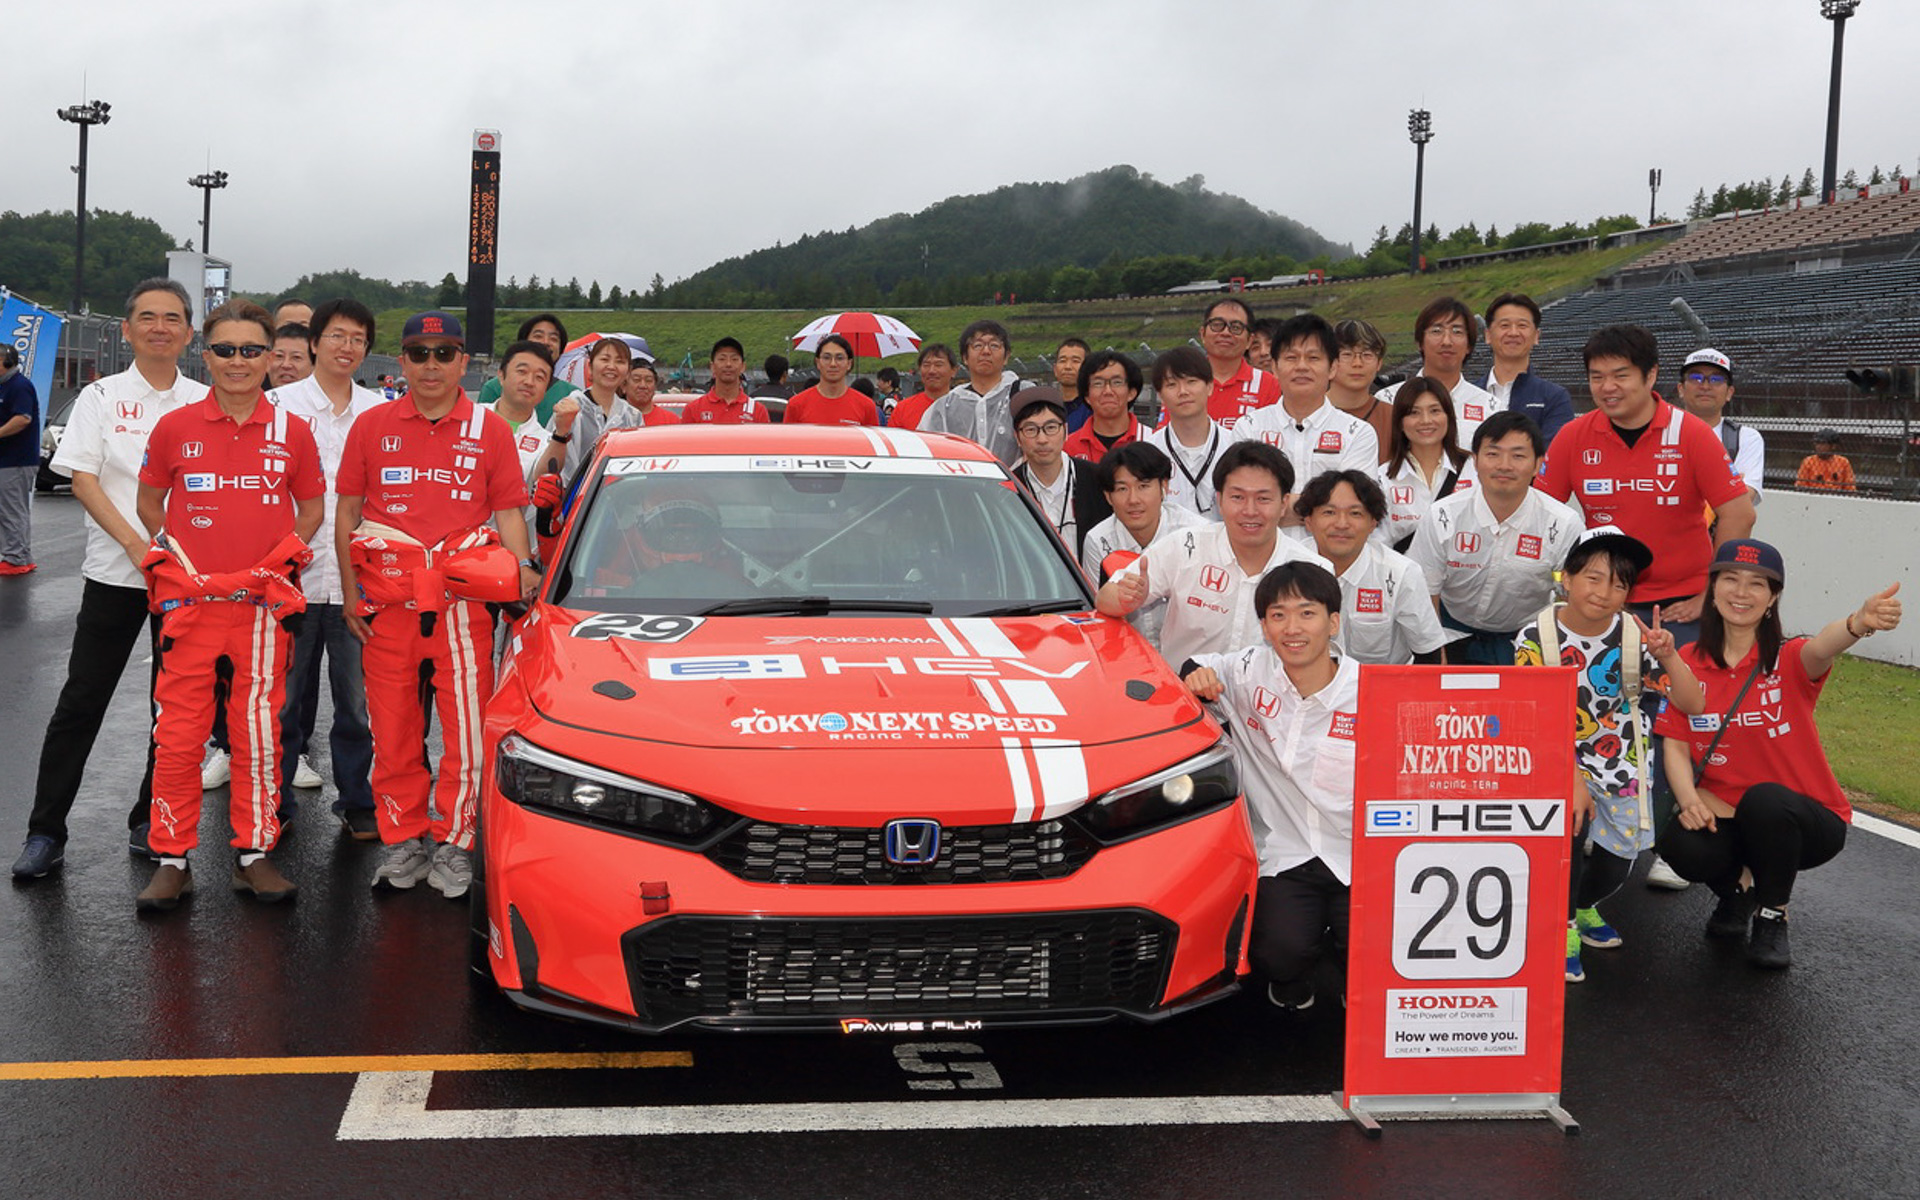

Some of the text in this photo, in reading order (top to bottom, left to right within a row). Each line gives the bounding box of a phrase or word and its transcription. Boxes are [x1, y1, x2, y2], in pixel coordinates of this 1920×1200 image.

[576, 615, 694, 640] 29
[849, 712, 945, 732] NEXT
[948, 712, 1057, 733] SPEED
[915, 732, 970, 740] TEAM
[1400, 743, 1531, 775] NEXT SPEED
[1429, 780, 1499, 790] RACING TEAM
[1407, 866, 1513, 960] 29
[1398, 995, 1499, 1010] HONDA
[1402, 1012, 1418, 1020] The
[1420, 1011, 1447, 1020] Power
[1460, 1011, 1495, 1019] Dreams
[931, 1020, 982, 1030] FILM
[1395, 1031, 1519, 1043] How we move you.
